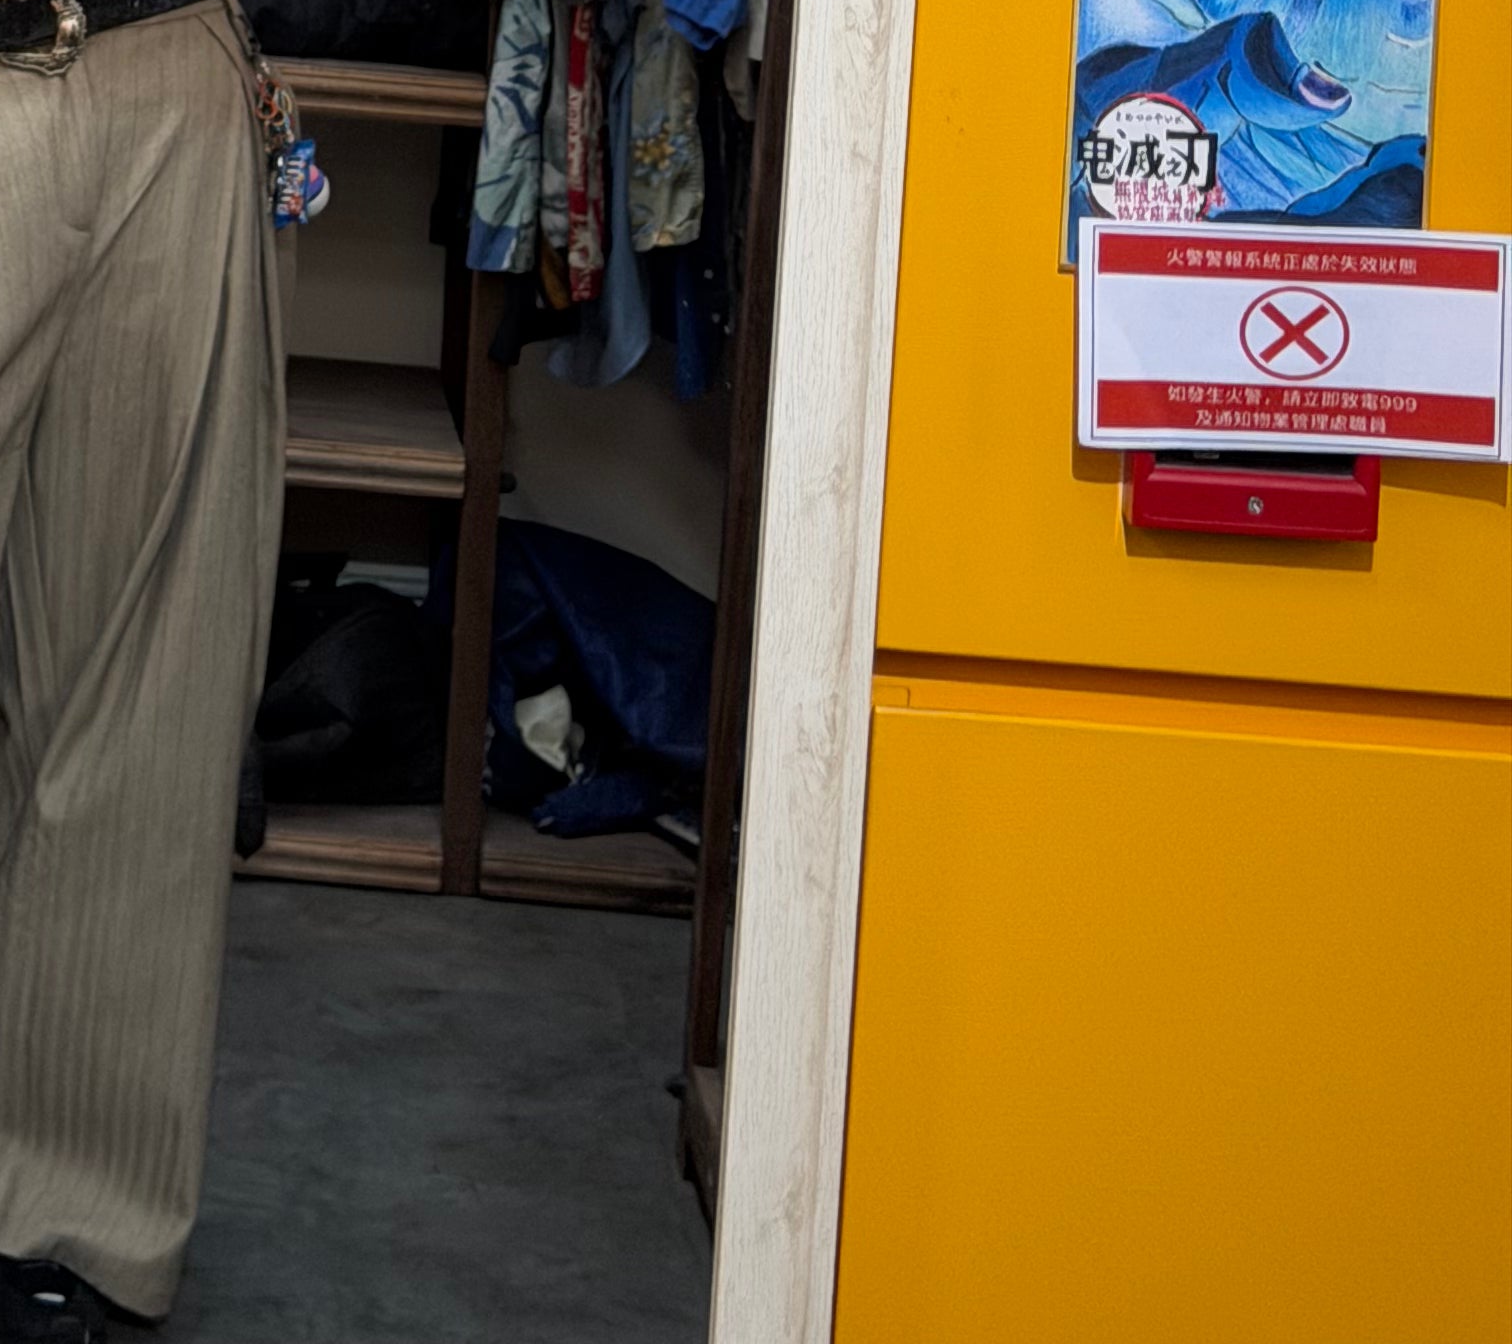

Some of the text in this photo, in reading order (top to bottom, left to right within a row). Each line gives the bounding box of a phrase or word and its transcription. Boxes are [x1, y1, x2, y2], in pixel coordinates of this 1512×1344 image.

[1166, 247, 1418, 275] 火警警報系統正處於失效狀態
[1194, 409, 1388, 434] 及通知物業管理處職員
